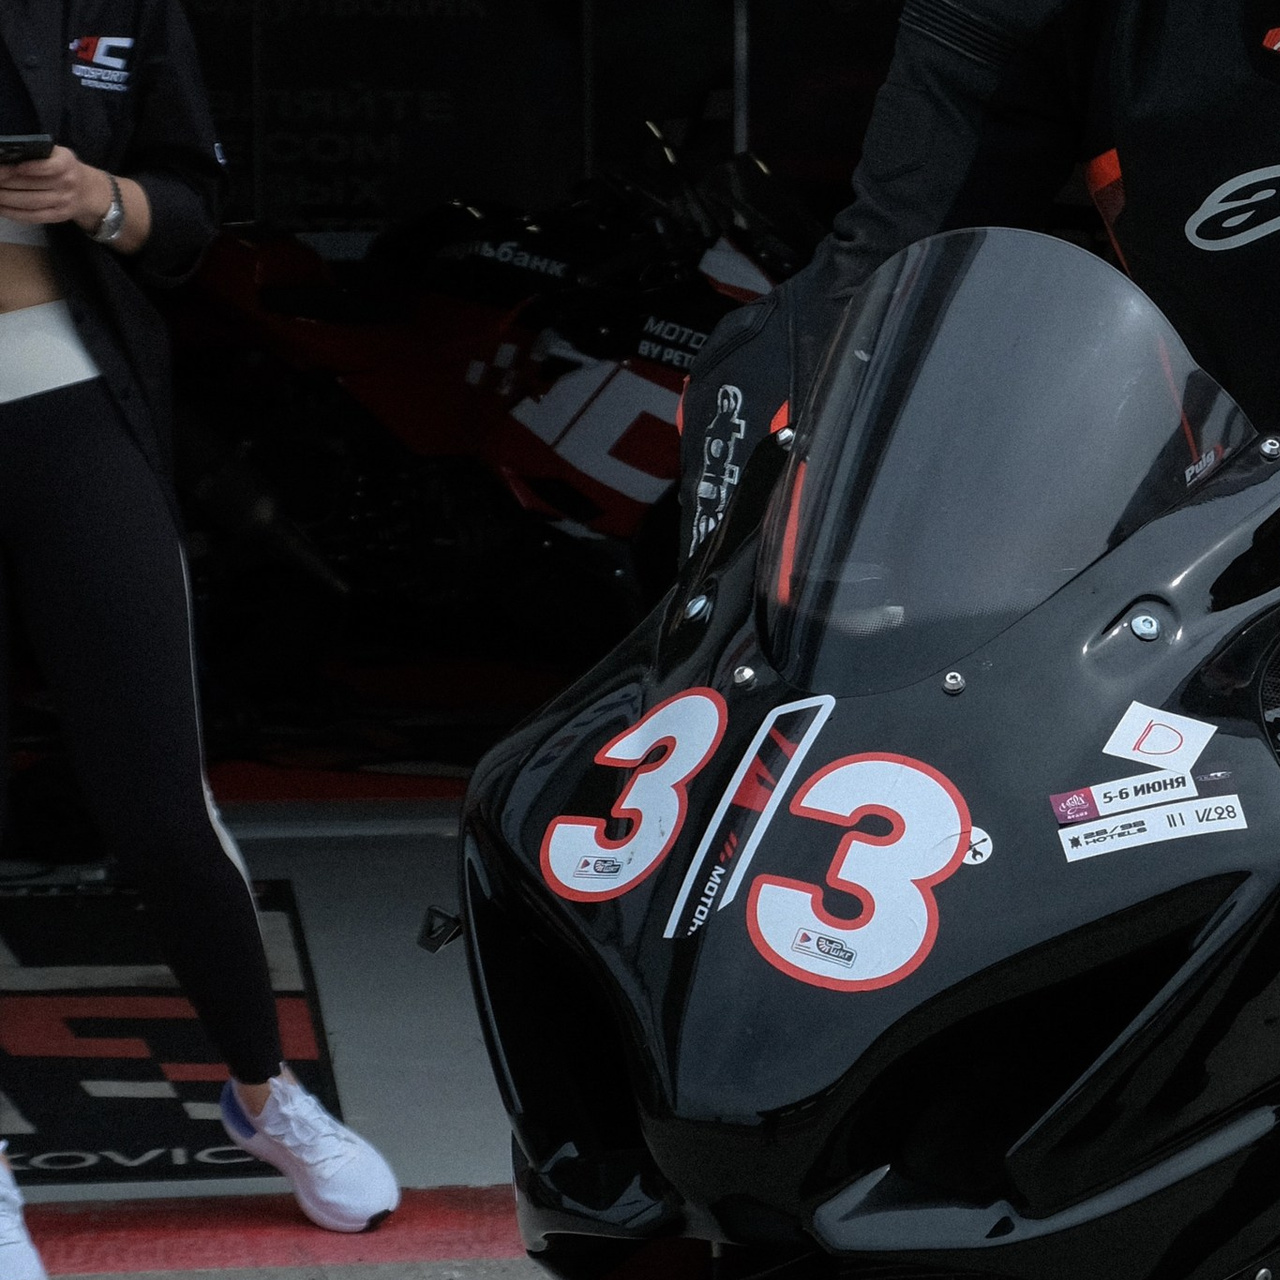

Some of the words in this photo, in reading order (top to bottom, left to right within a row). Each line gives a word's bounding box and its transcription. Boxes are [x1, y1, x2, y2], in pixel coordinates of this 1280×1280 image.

[539, 686, 728, 904] 3
[1085, 827, 1148, 846] HOTELS
[1103, 788, 1130, 804] 5-6
[1133, 775, 1187, 797] ИЮНЯ
[745, 751, 973, 993] 3
